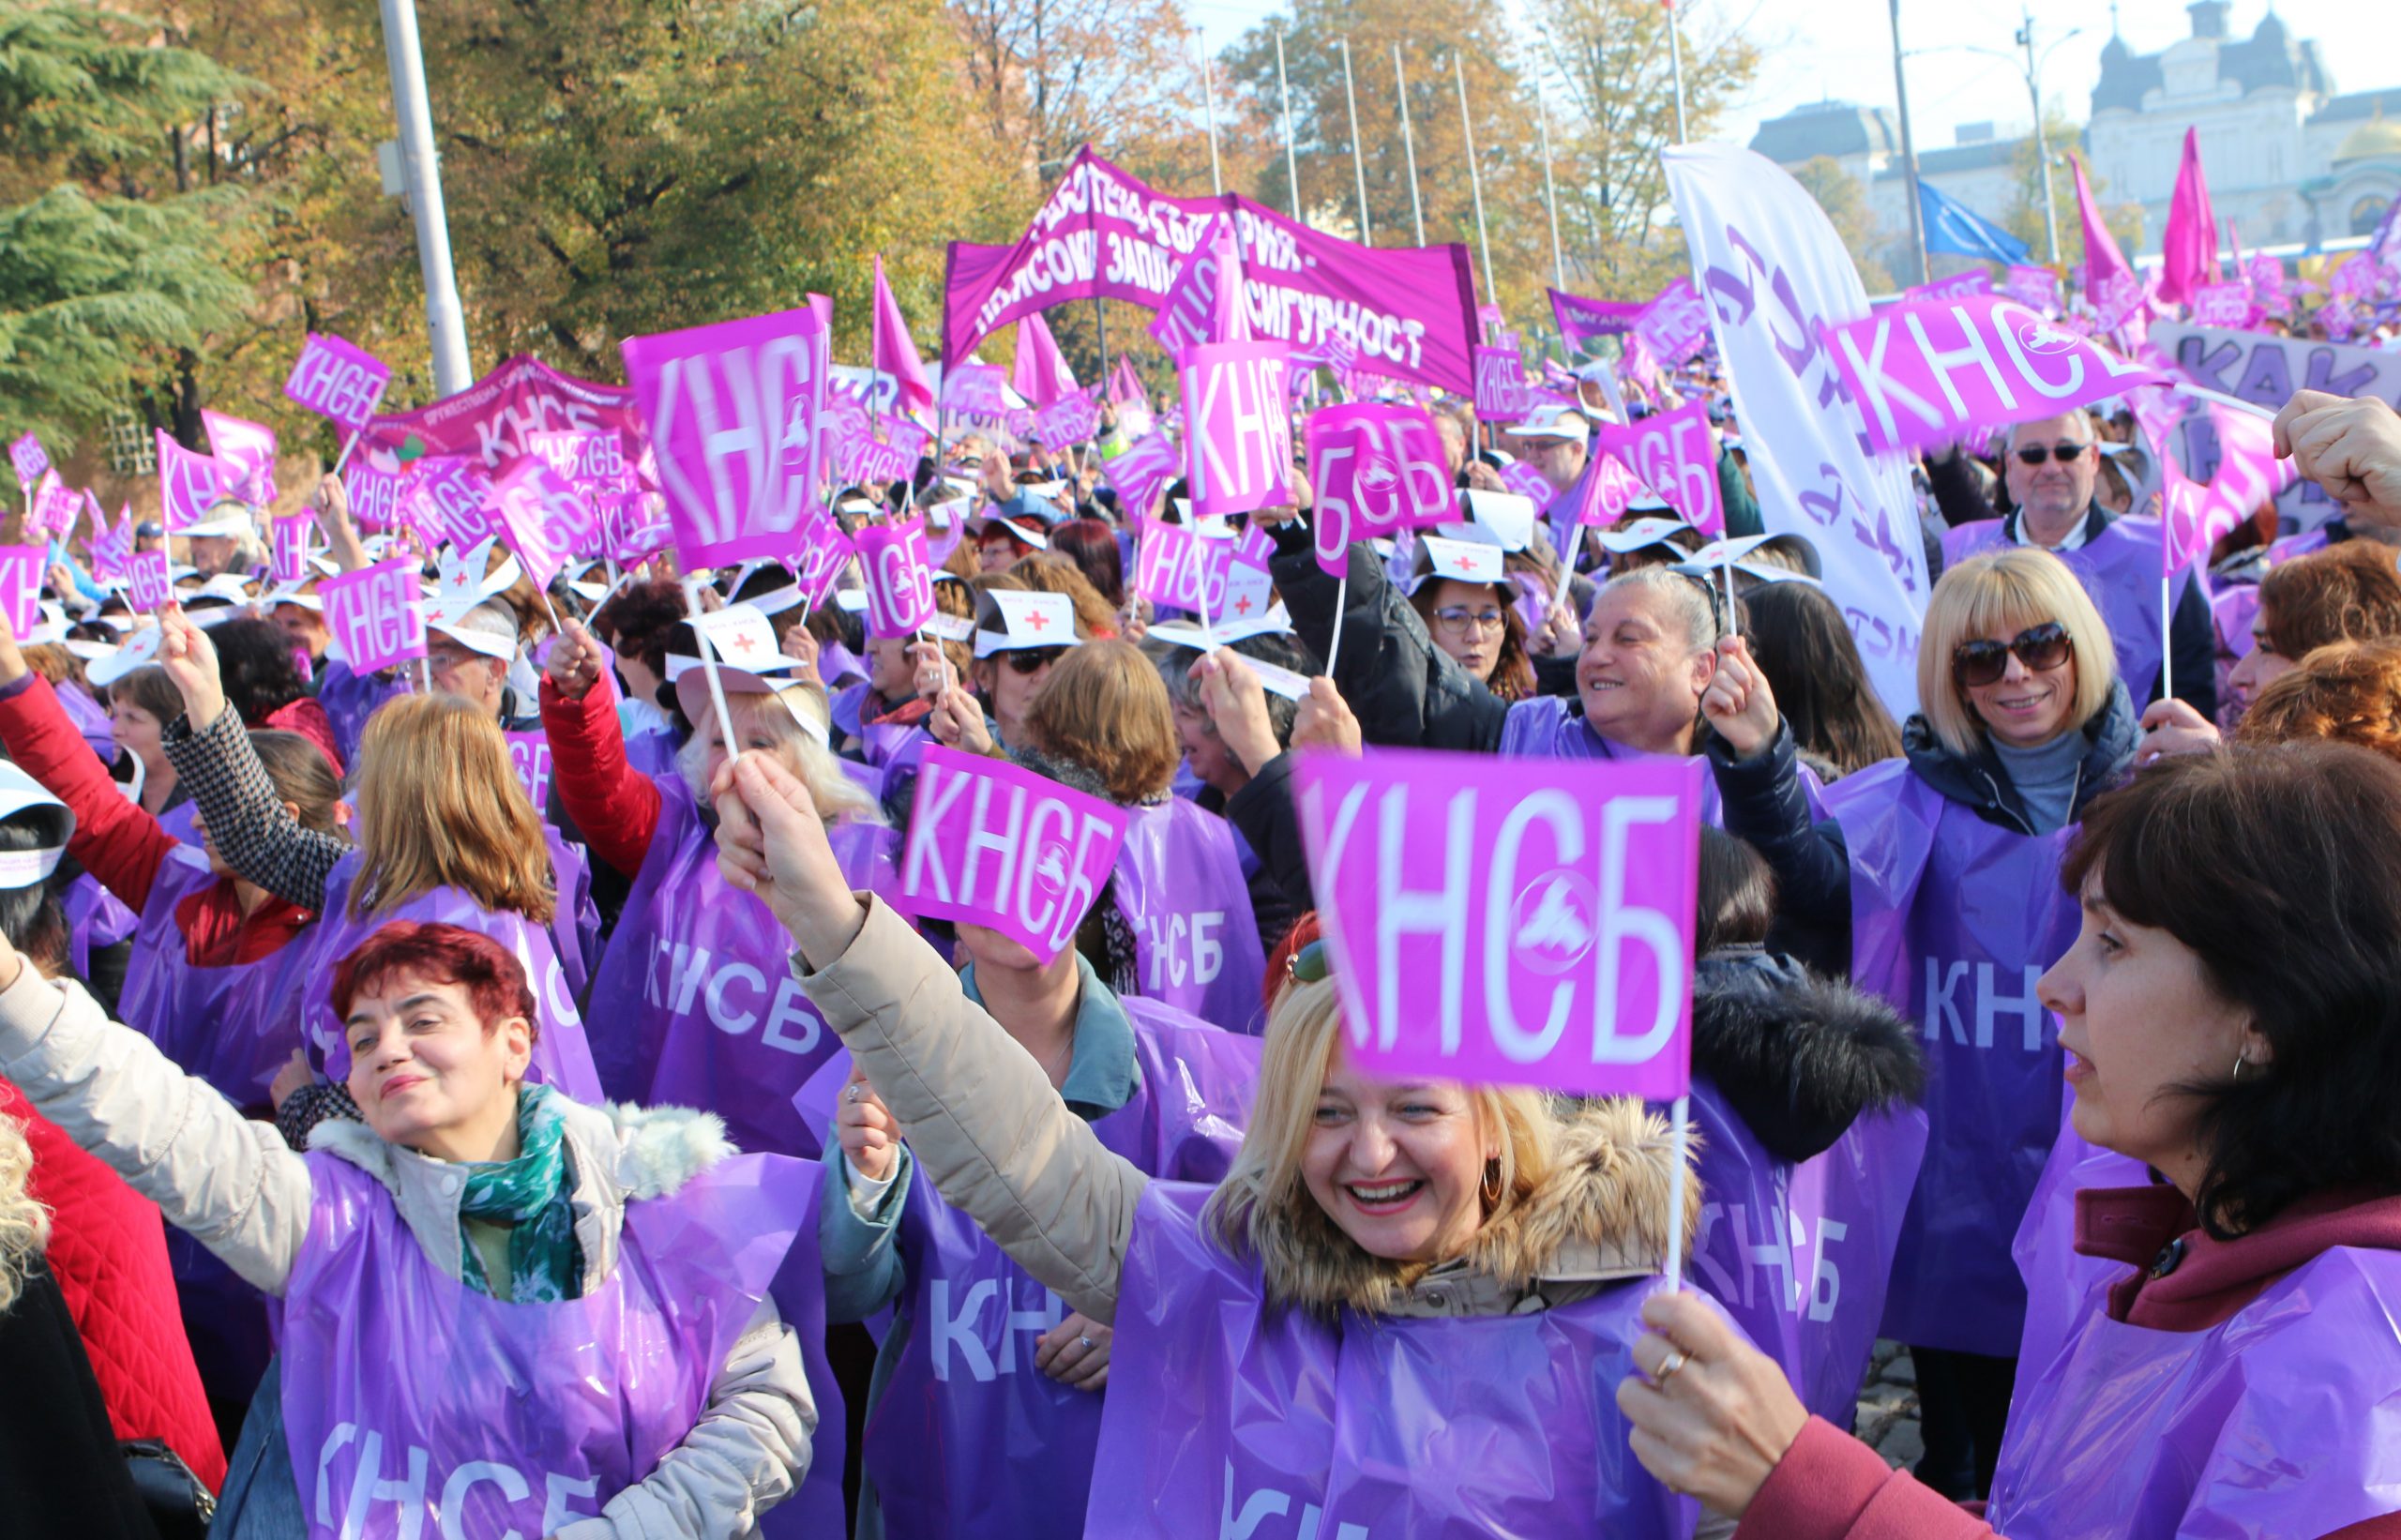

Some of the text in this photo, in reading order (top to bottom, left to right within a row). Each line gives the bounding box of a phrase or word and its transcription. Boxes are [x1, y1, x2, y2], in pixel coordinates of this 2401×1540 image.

[1243, 278, 1426, 370] СИГУРНОСТ
[904, 762, 1114, 954] КНСБ
[1147, 910, 1226, 991] НСБ
[1300, 777, 1684, 1065] КНСБ
[1924, 956, 2043, 1052] КН
[930, 1276, 1064, 1382] КН
